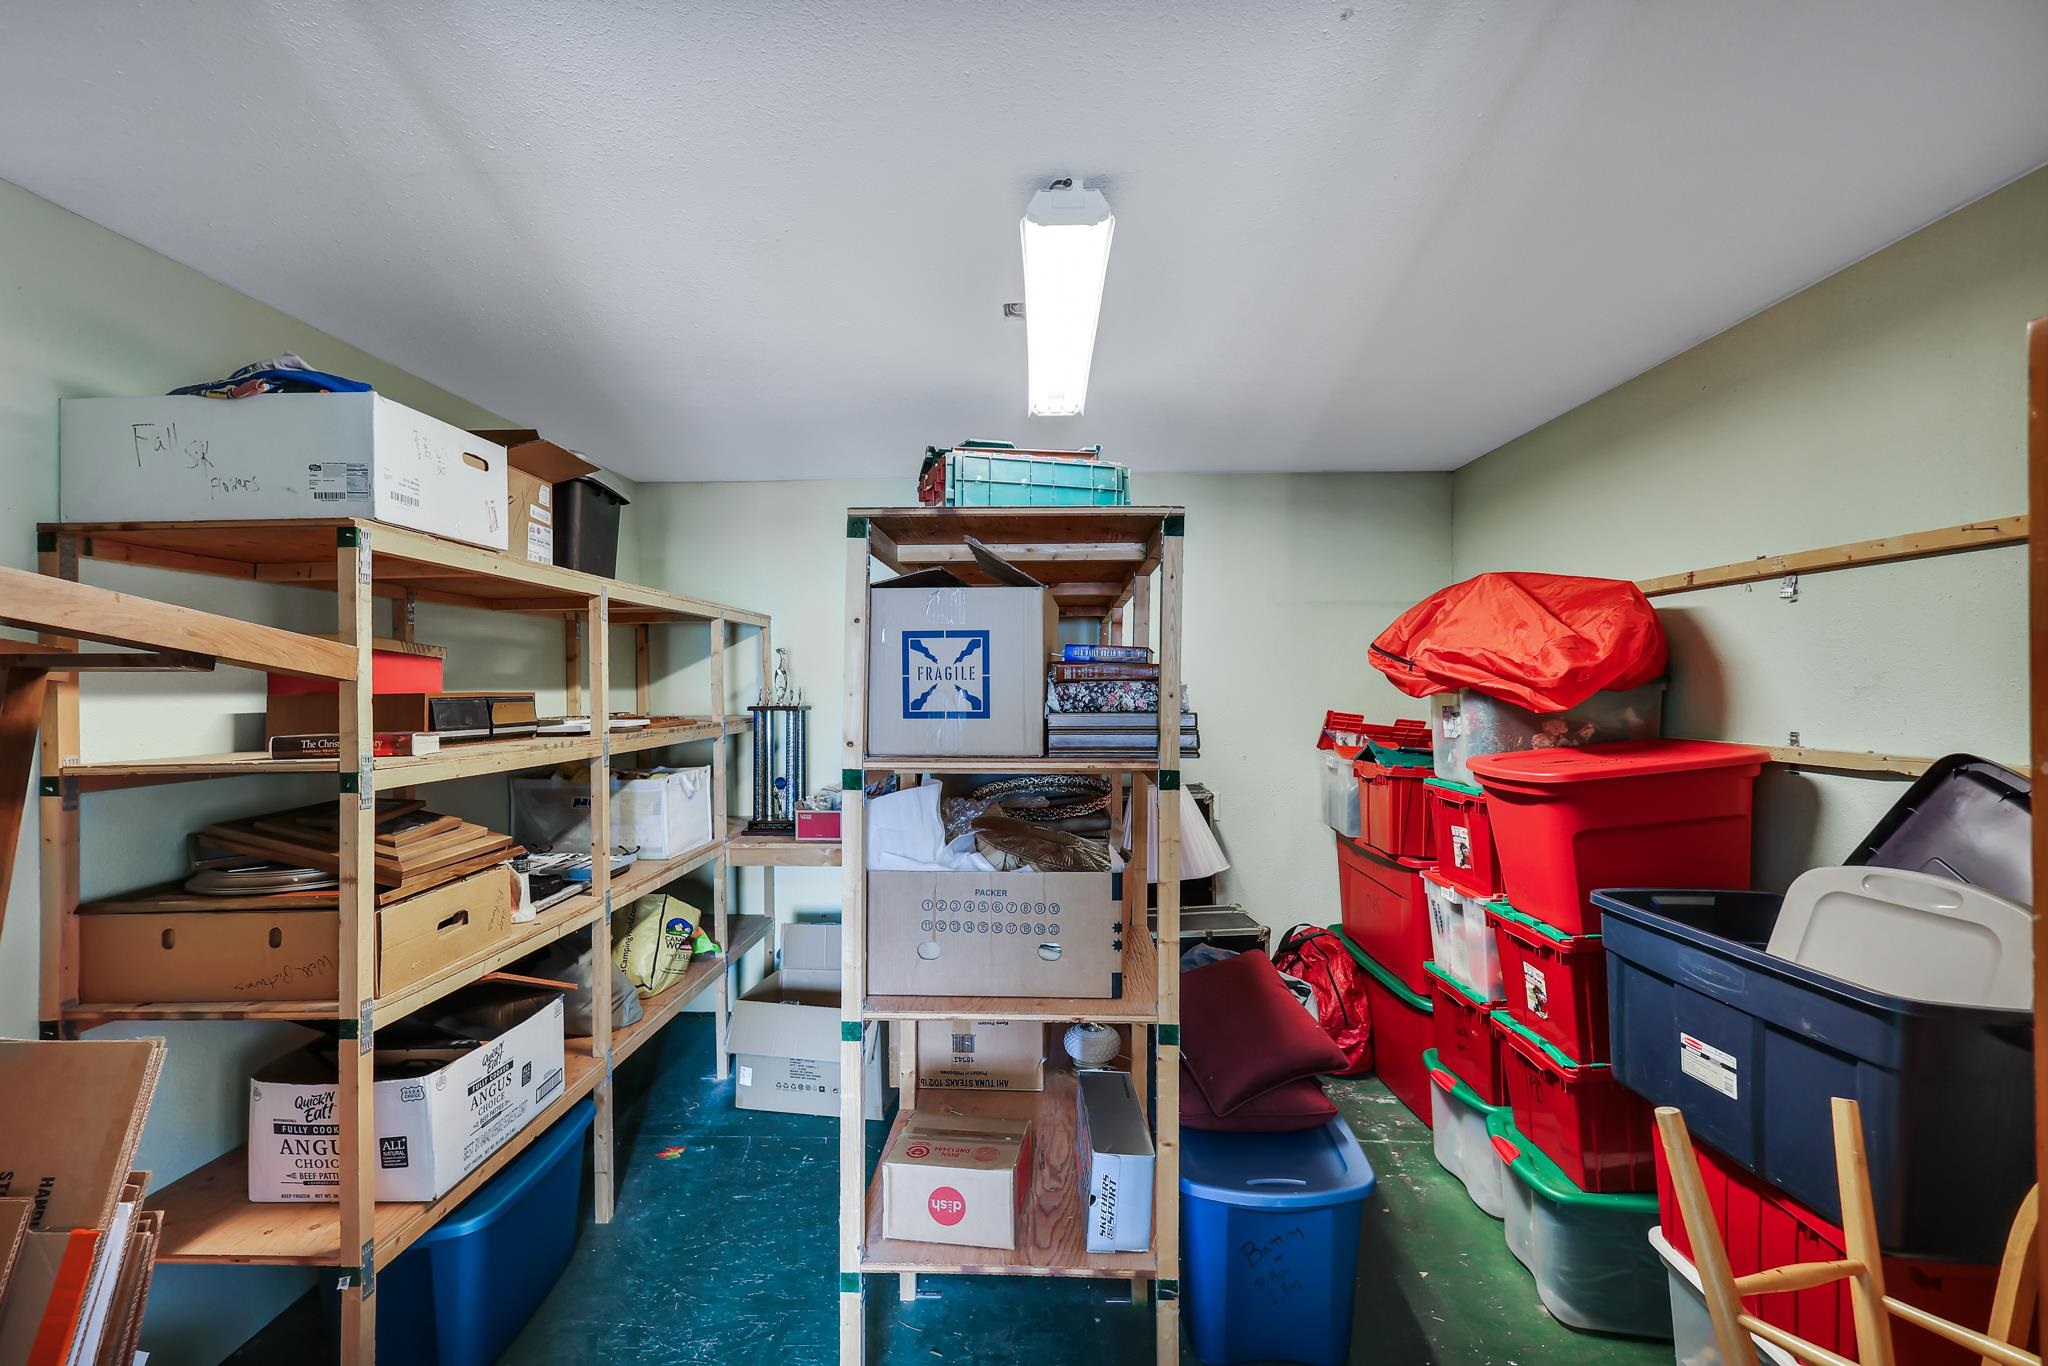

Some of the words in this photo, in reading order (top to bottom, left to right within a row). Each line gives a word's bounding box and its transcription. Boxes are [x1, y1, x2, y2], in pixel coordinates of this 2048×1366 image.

[131, 422, 177, 467] Fall
[917, 665, 976, 681] FRAGILE
[301, 739, 316, 749] The
[318, 739, 341, 749] Christ
[974, 888, 1008, 897] PACKER
[945, 1079, 974, 1088] STEAKS
[974, 1079, 995, 1088] TUNA
[470, 1072, 512, 1112] ANGUS
[294, 1091, 336, 1110] Quick'N
[478, 1092, 505, 1116] CHOICE
[303, 1103, 333, 1123] Eat!
[281, 1125, 308, 1134] FULLY
[312, 1125, 340, 1134] COOK
[279, 1138, 340, 1156] ANGU
[382, 1140, 405, 1151] ALL
[294, 1158, 340, 1169] CHOIC
[299, 1172, 317, 1180] BEEF
[318, 1172, 340, 1180] PATTI
[931, 1199, 962, 1213] dish
[1099, 1173, 1109, 1237] SKECHERS
[1107, 1178, 1117, 1224] SPORT
